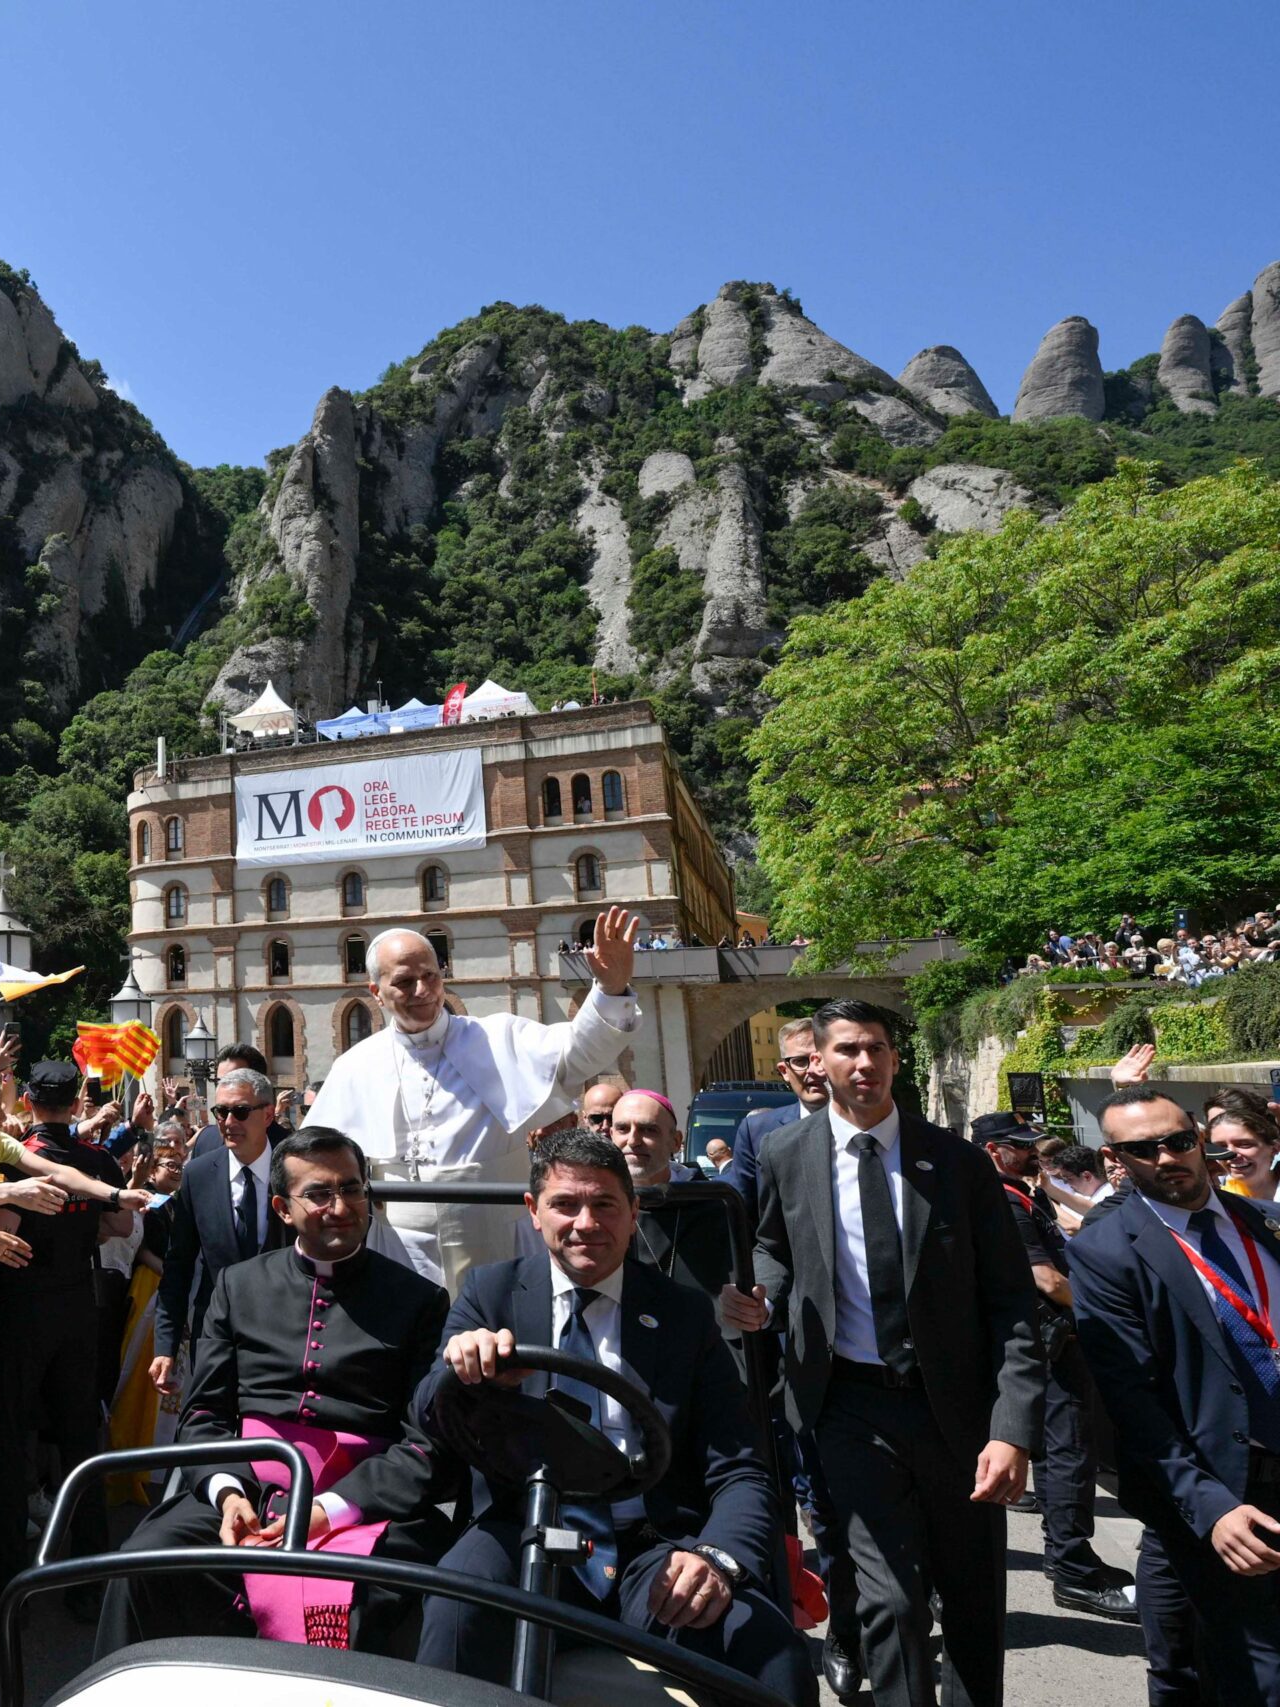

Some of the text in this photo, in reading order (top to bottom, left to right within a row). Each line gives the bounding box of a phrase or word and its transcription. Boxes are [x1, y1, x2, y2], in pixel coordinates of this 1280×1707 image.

[363, 780, 390, 793] ORA
[364, 792, 397, 806] LEGE
[365, 804, 416, 819] LABORA
[365, 812, 465, 831] REGE TE IPSUM
[366, 825, 465, 843] IN COMMUNITATE
